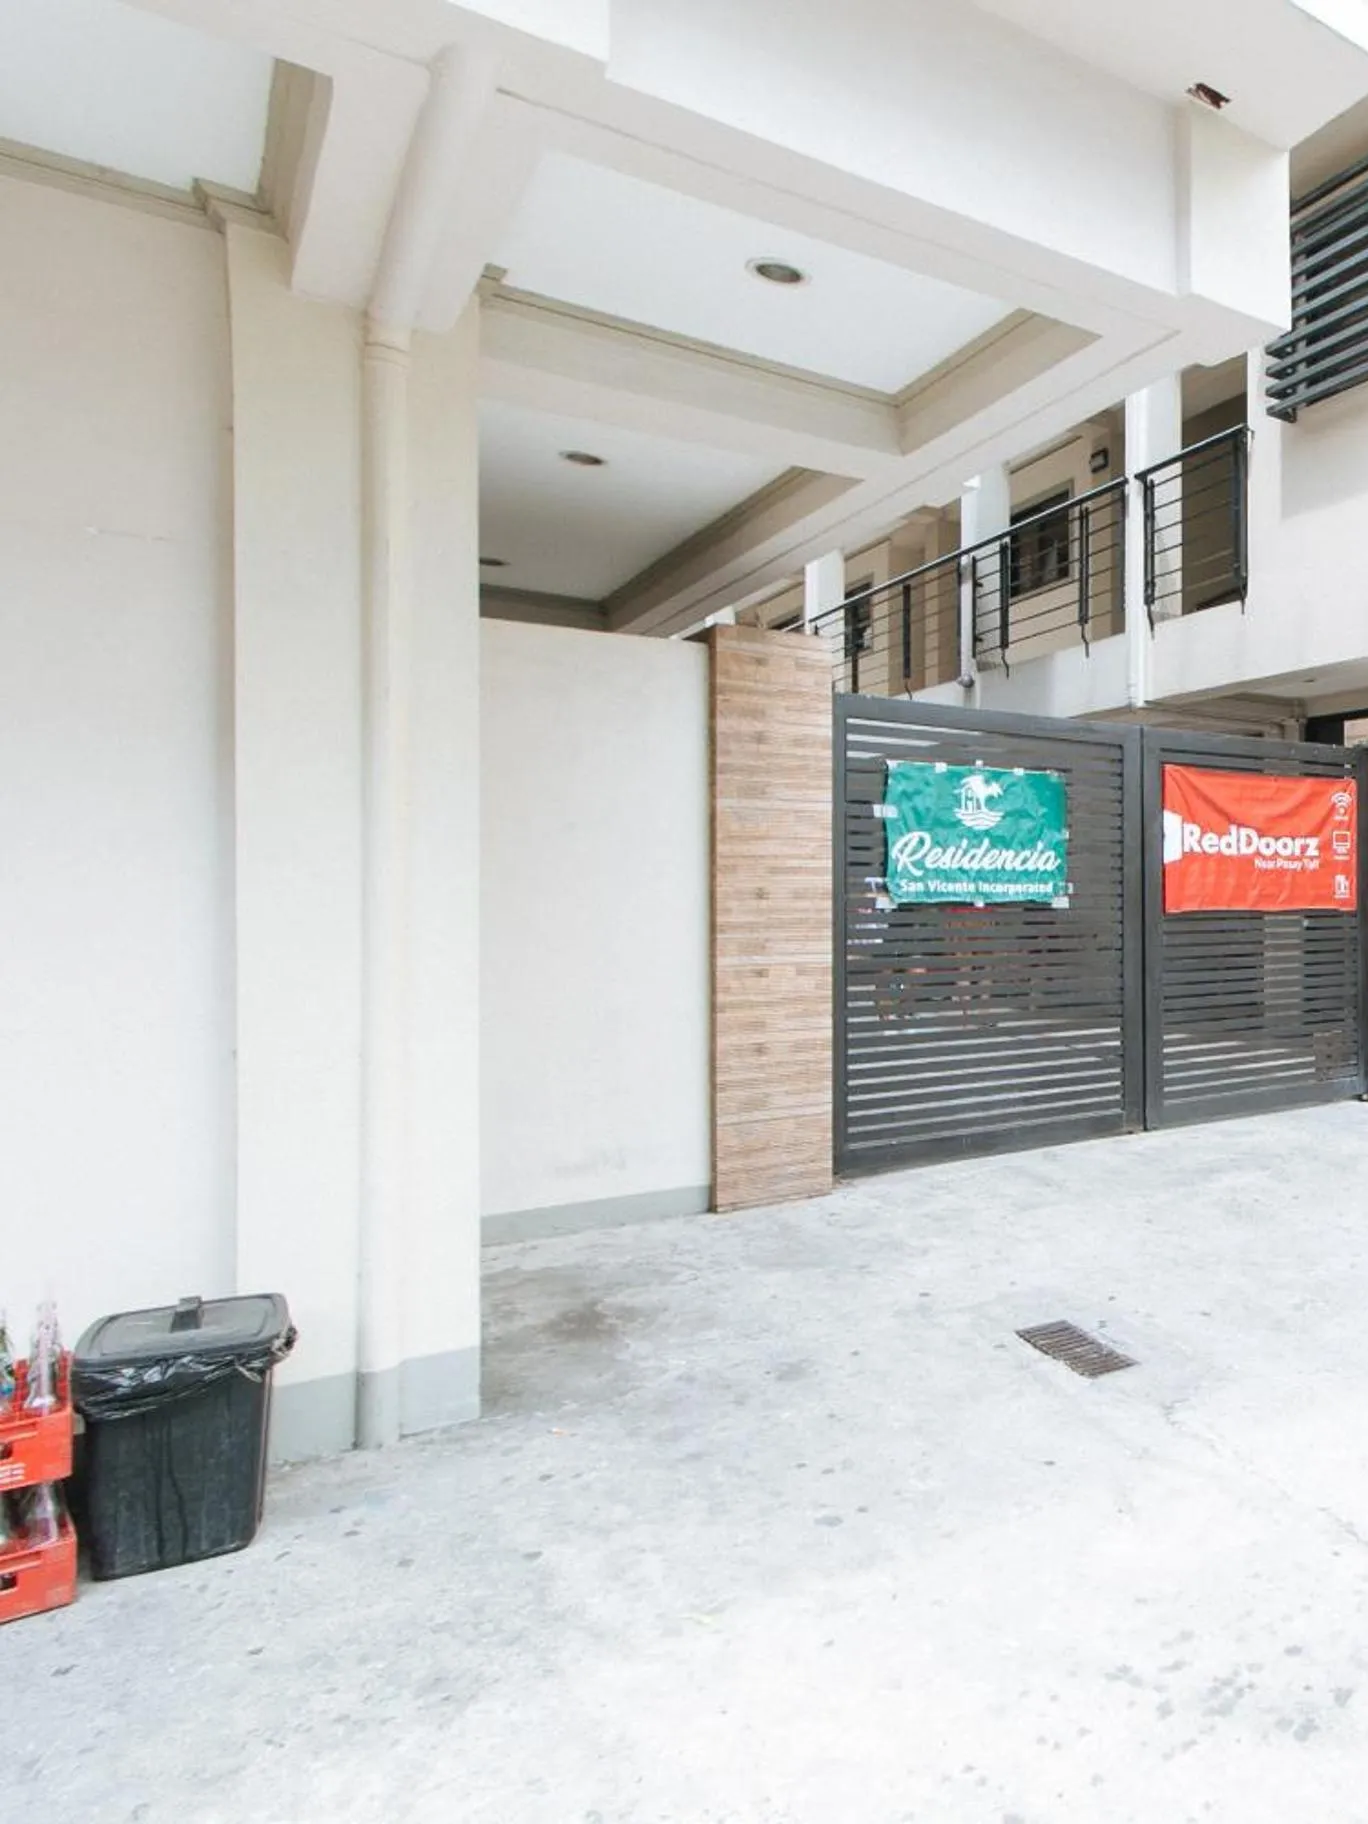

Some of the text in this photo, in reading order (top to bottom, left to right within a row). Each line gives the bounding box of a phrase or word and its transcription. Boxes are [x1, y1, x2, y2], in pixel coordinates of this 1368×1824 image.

[892, 831, 1061, 876] Residencia
[1183, 823, 1320, 857] RedDoorz
[900, 879, 1053, 895] San Vicente Incorporated
